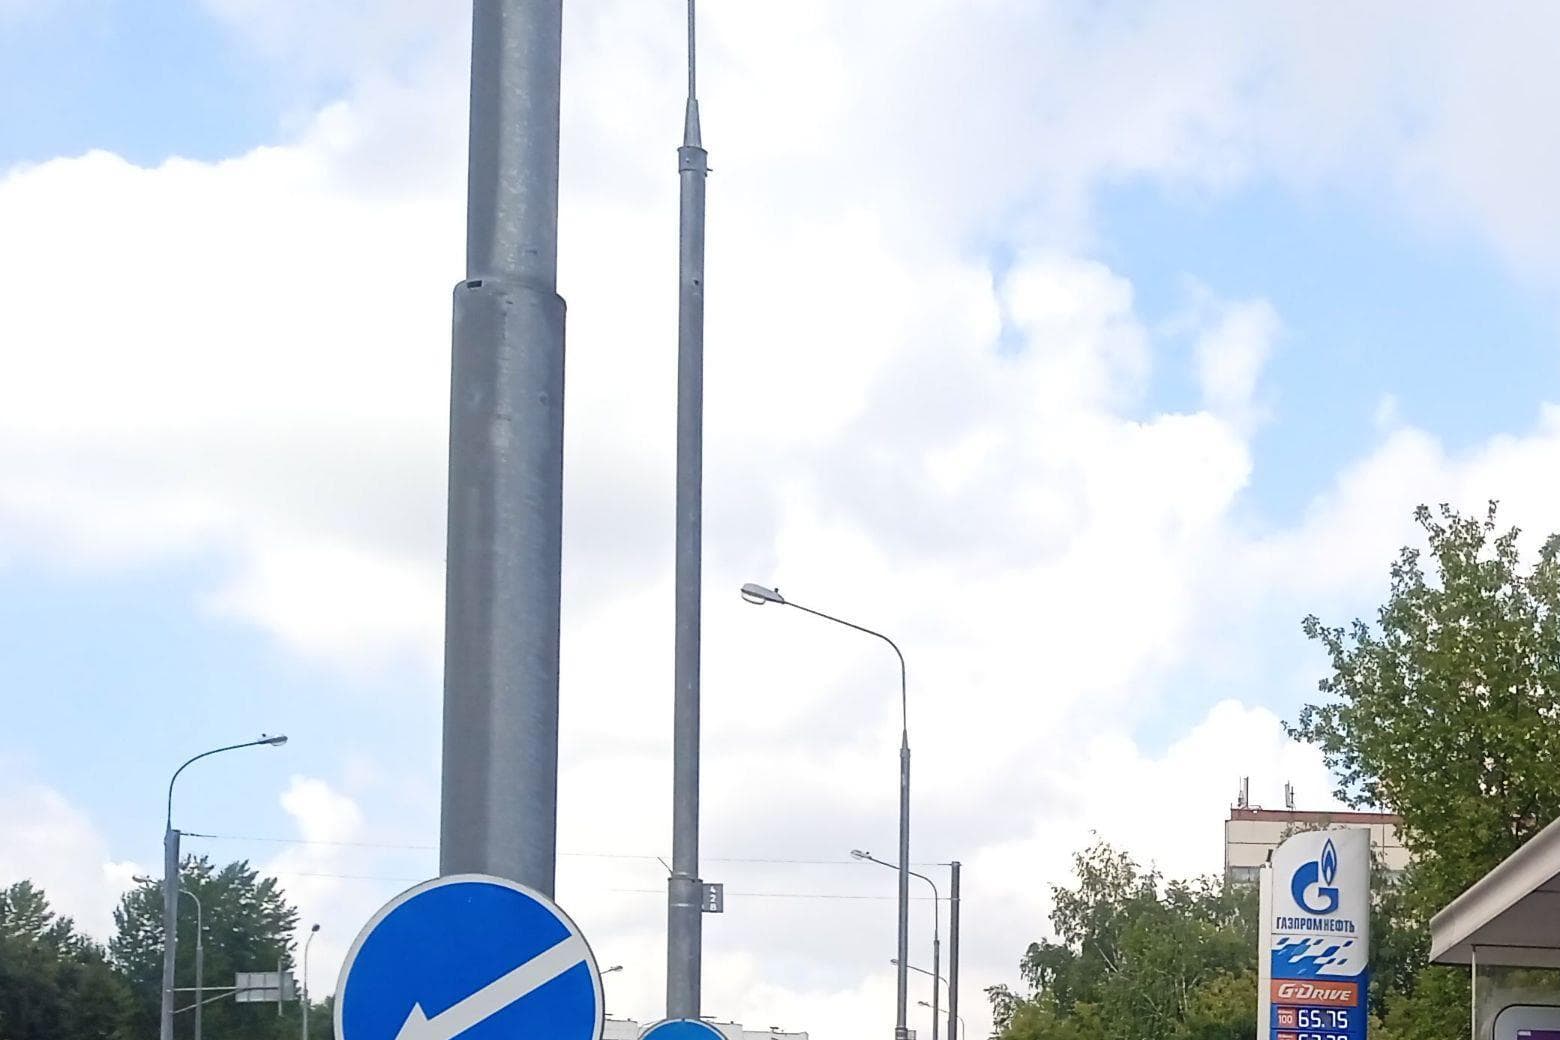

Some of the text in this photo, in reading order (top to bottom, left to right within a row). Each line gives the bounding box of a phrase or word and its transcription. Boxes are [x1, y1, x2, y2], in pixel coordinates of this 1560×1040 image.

[1276, 916, 1356, 933] ГАЗПРОМНЕФТЬ
[1278, 1010, 1348, 1028] 100 65.75
